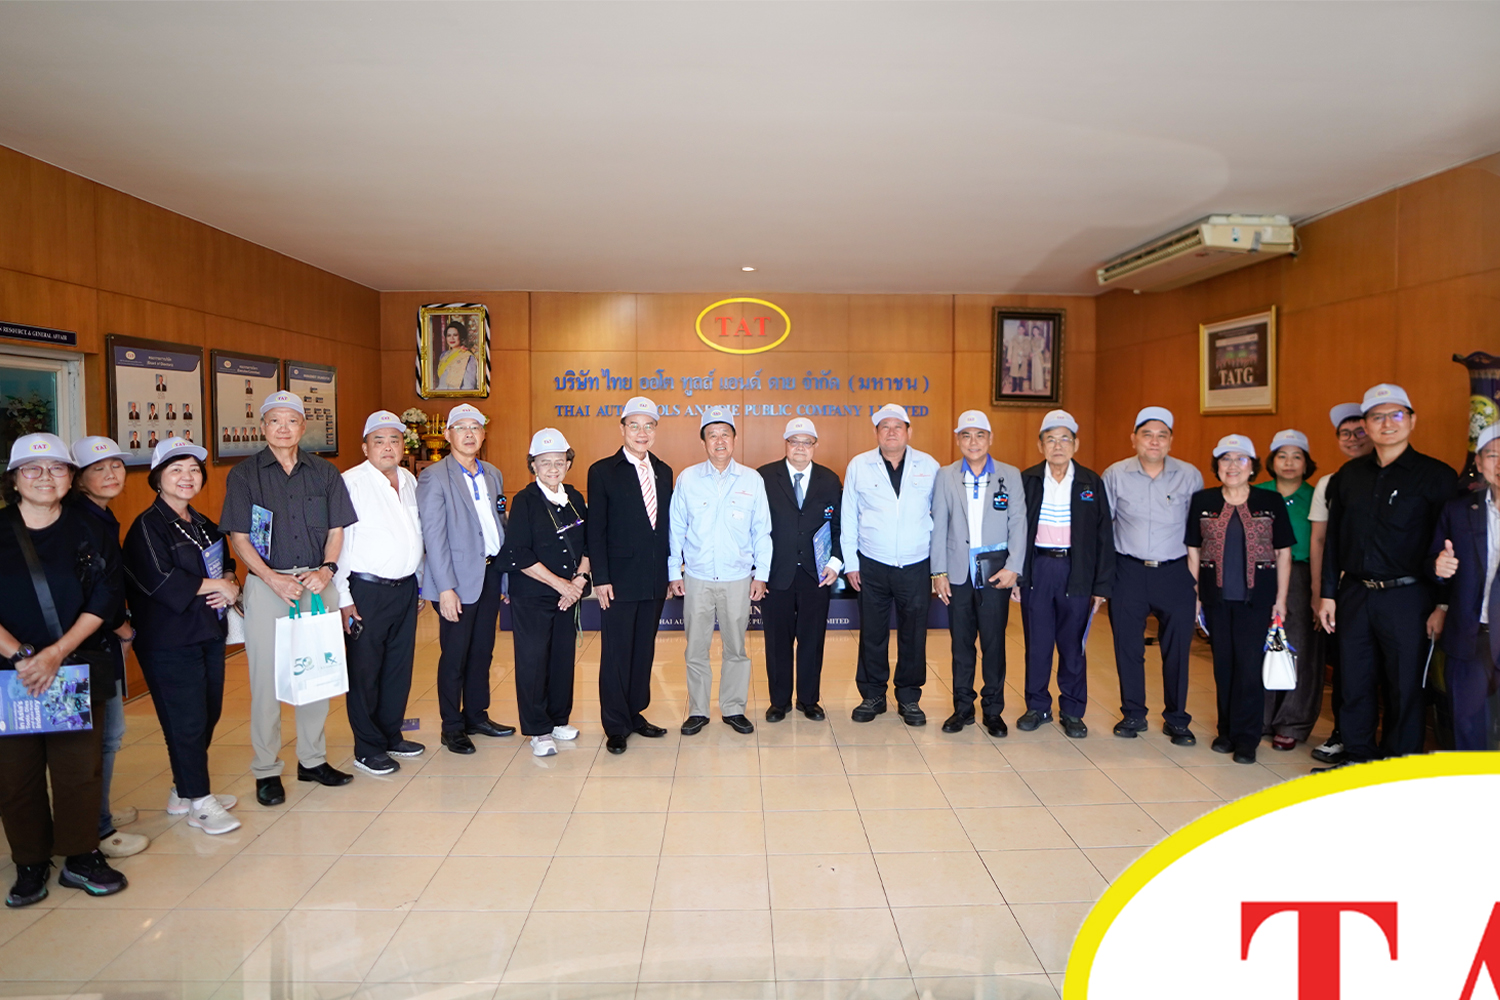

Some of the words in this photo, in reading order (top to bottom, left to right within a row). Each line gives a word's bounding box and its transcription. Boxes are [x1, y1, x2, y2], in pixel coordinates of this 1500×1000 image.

[715, 316, 771, 337] TAT
[554, 370, 599, 390] บริษัท
[601, 369, 632, 390] ไทย
[681, 369, 716, 396] ทูลส์
[719, 369, 763, 390] แอนด์
[768, 376, 796, 390] ดาย
[802, 370, 840, 390] จำกัด
[1220, 367, 1253, 386] TATG
[555, 405, 590, 416] THAI
[745, 405, 792, 416] PUBLIC
[796, 405, 862, 417] COMPANY
